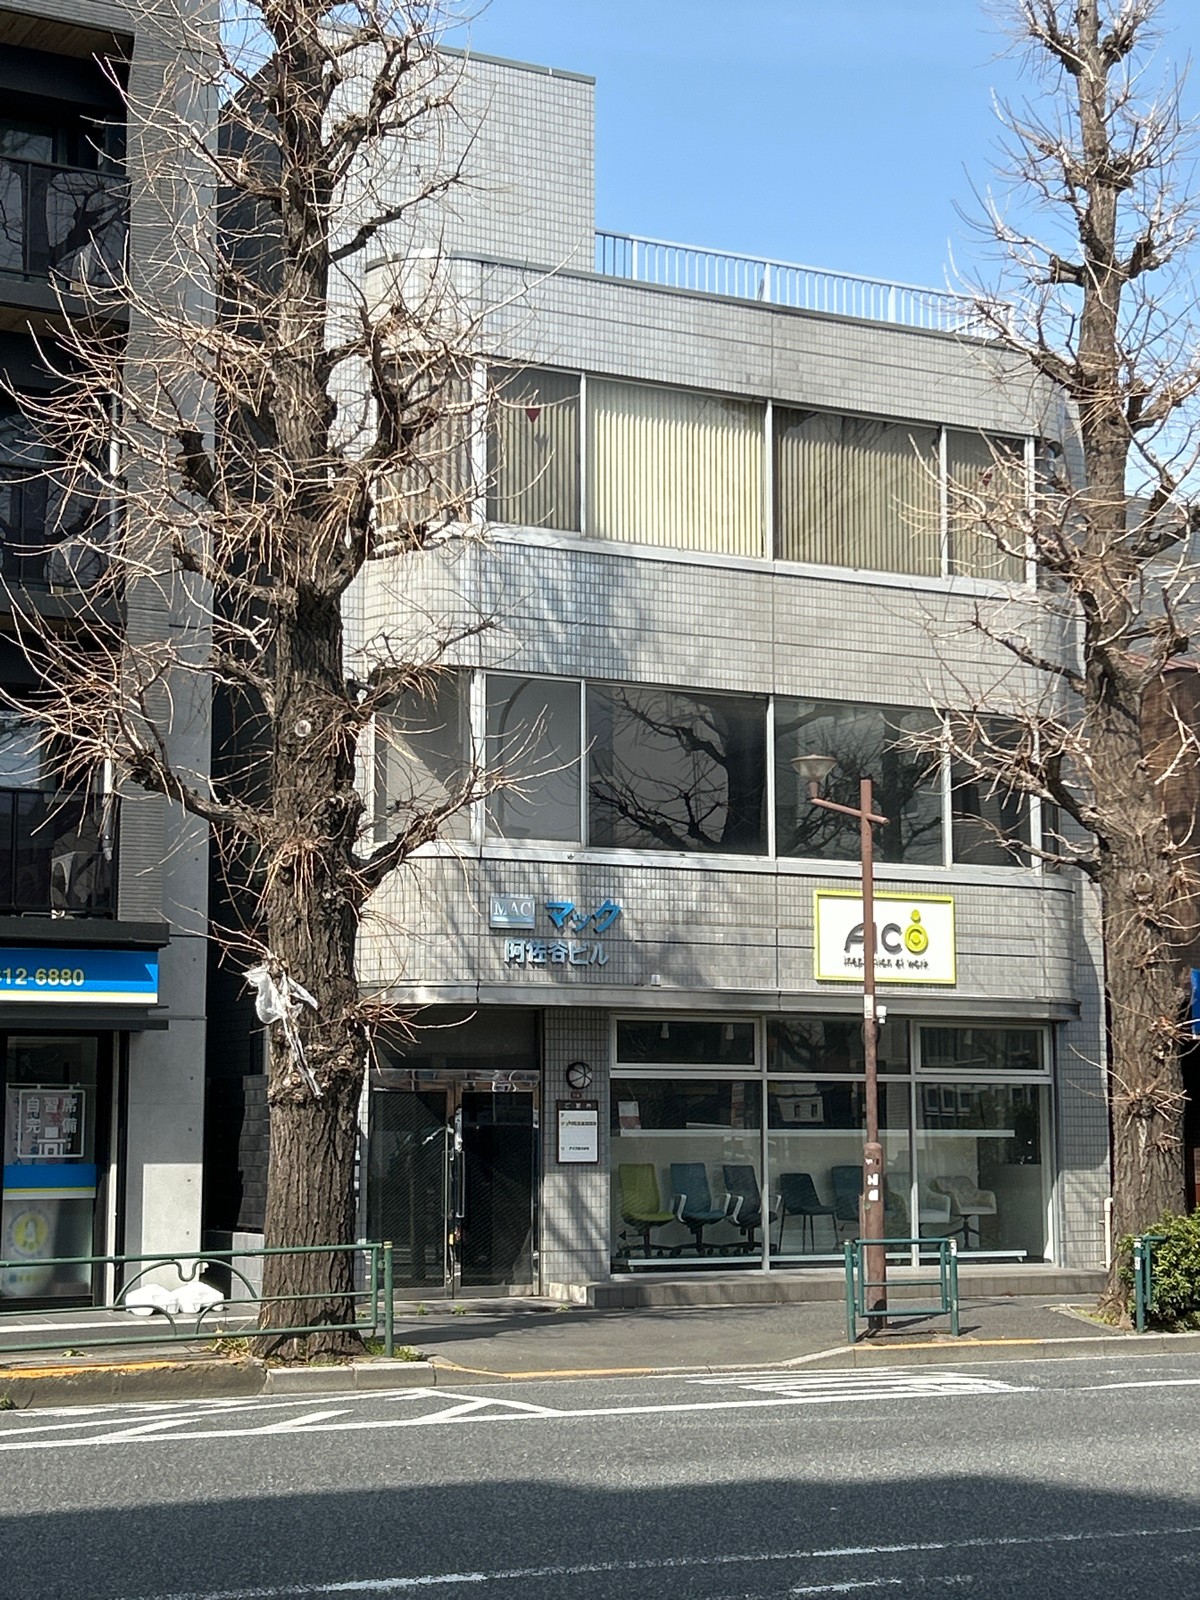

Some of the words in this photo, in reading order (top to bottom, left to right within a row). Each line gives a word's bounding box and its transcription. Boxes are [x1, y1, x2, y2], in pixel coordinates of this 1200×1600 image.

[493, 901, 533, 918] MAC
[546, 899, 622, 934] マック
[503, 939, 609, 965] 阿佐谷ビル
[0, 967, 85, 987] 12-6880
